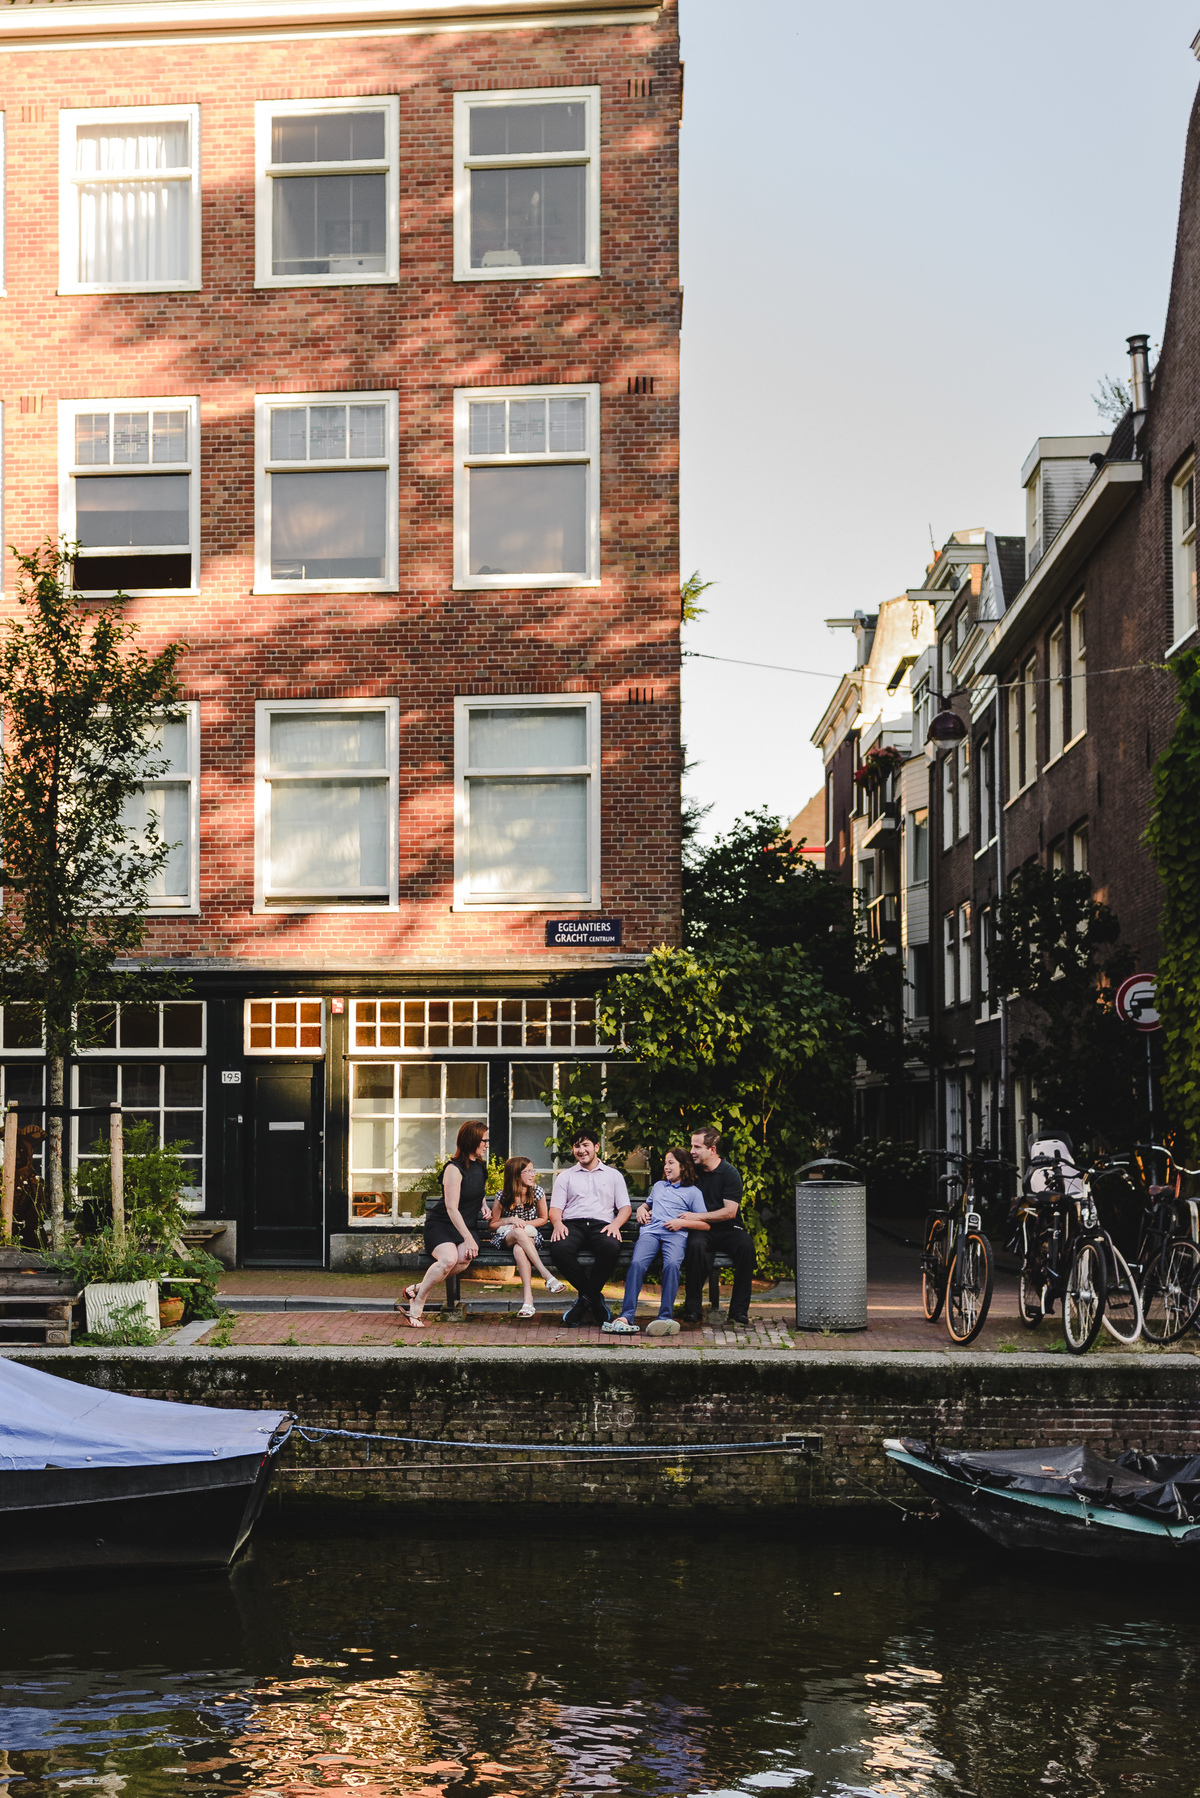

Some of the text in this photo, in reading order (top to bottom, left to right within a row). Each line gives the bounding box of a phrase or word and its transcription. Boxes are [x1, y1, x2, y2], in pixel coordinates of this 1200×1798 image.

[558, 922, 611, 932] EGELANTIERS
[554, 933, 588, 943] GRACHT
[223, 1073, 240, 1082] 195
